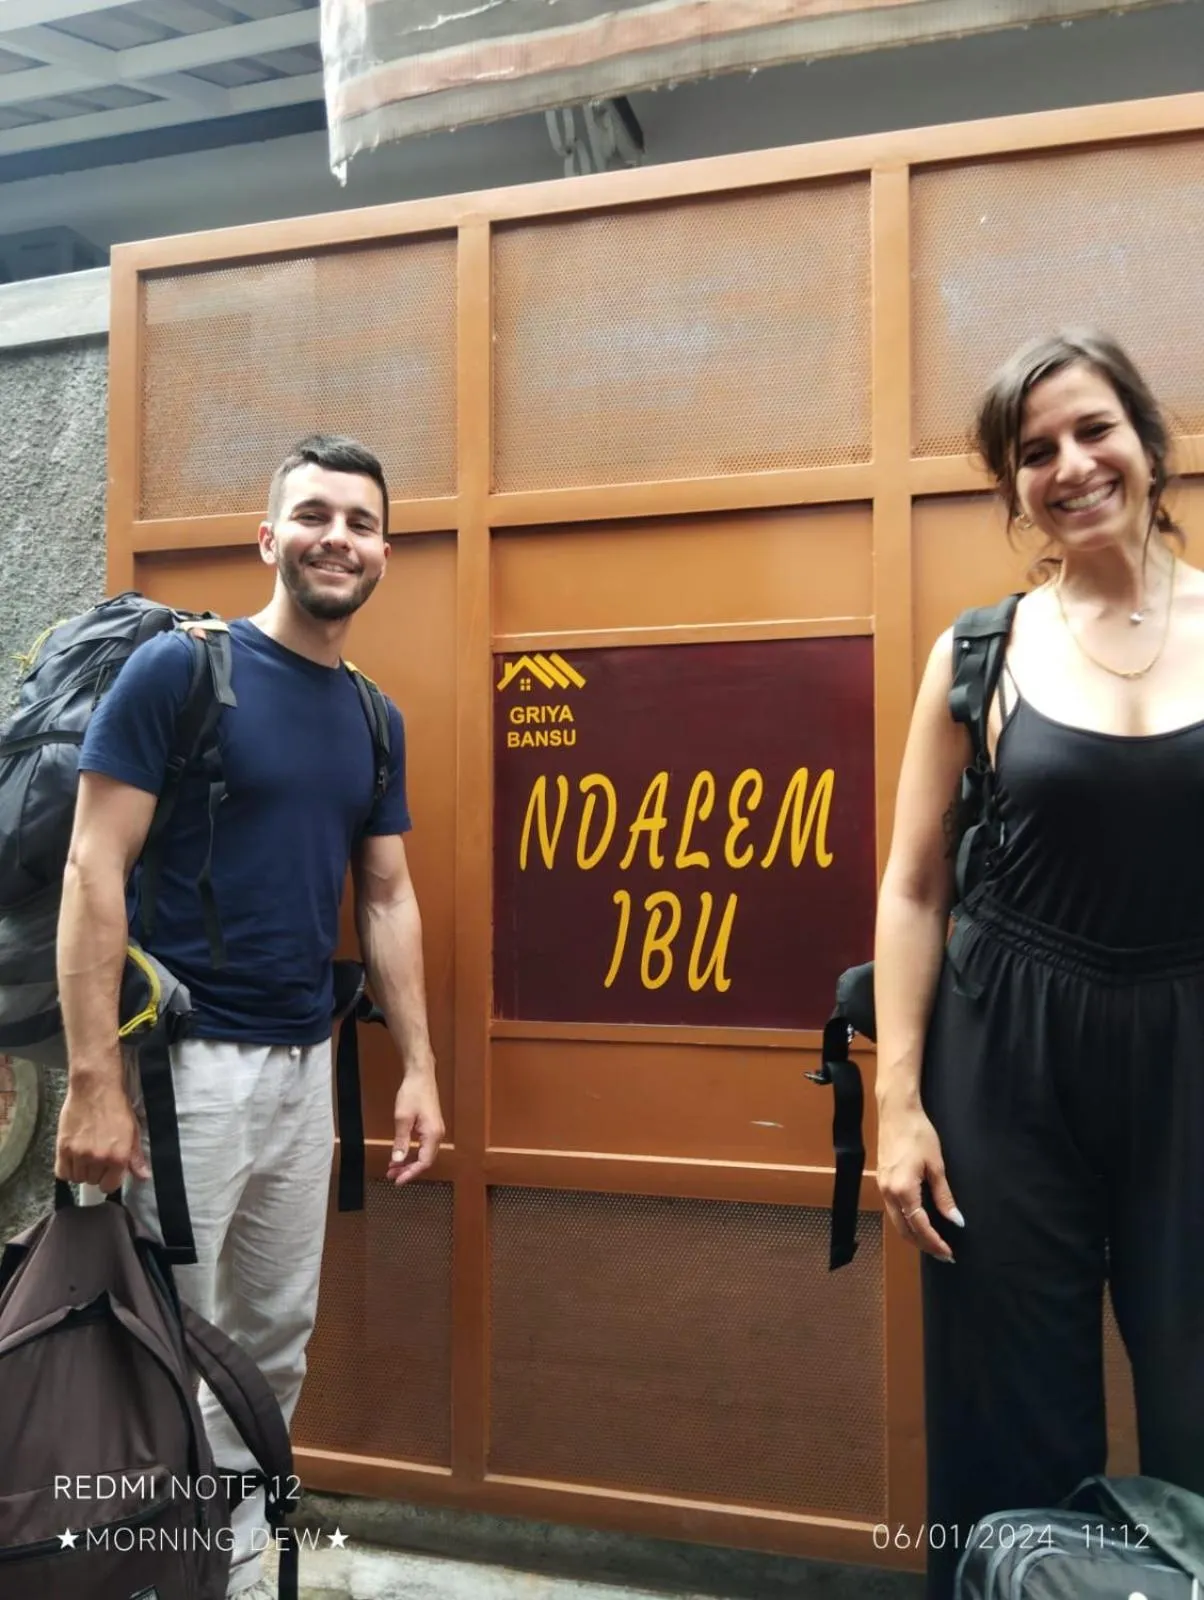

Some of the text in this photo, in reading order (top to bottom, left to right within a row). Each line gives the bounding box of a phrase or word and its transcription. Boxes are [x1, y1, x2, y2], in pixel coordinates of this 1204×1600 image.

[507, 729, 577, 749] BANSU
[510, 704, 574, 725] GRIYA
[519, 767, 836, 871] NDALEM
[604, 889, 738, 993] IBU
